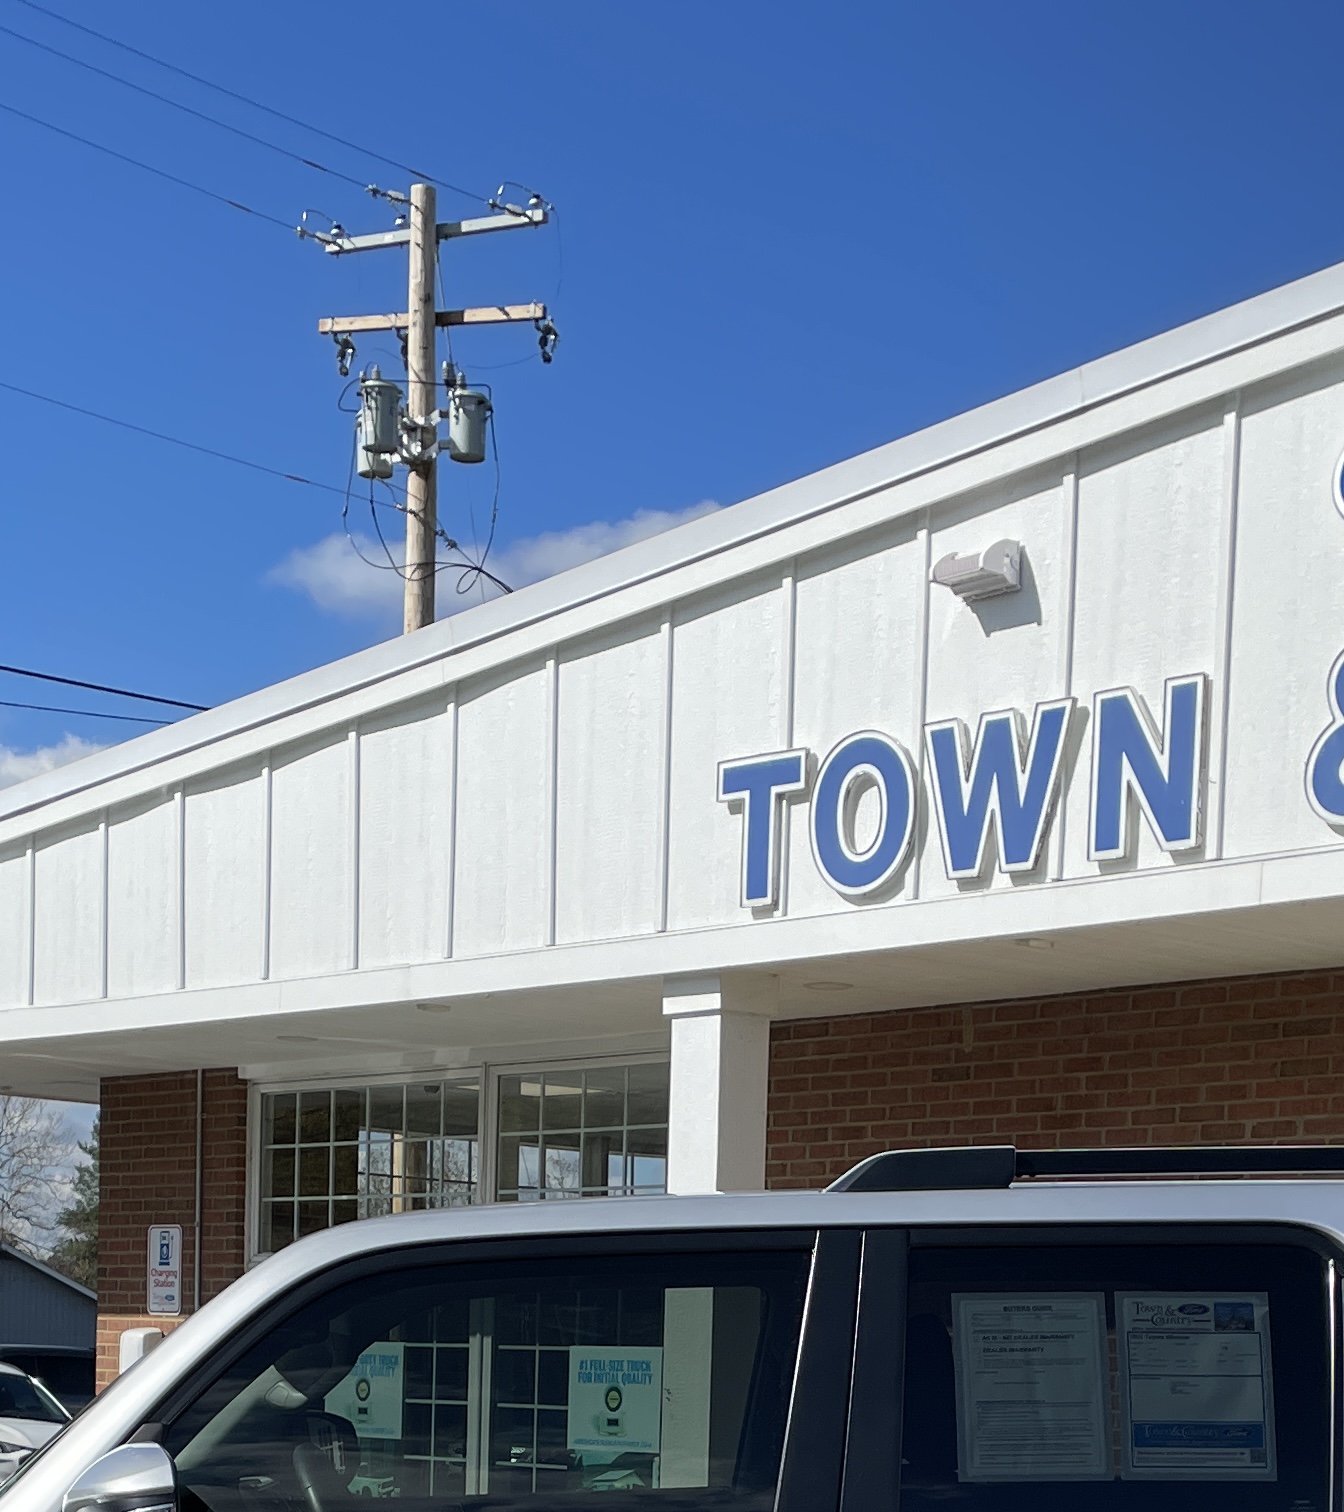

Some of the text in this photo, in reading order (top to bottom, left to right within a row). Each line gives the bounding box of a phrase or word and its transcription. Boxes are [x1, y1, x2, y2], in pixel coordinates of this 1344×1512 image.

[718, 672, 1208, 909] TOWN
[151, 1268, 177, 1279] Charging
[154, 1279, 175, 1287] Station
[621, 1371, 653, 1387] QUALITY
